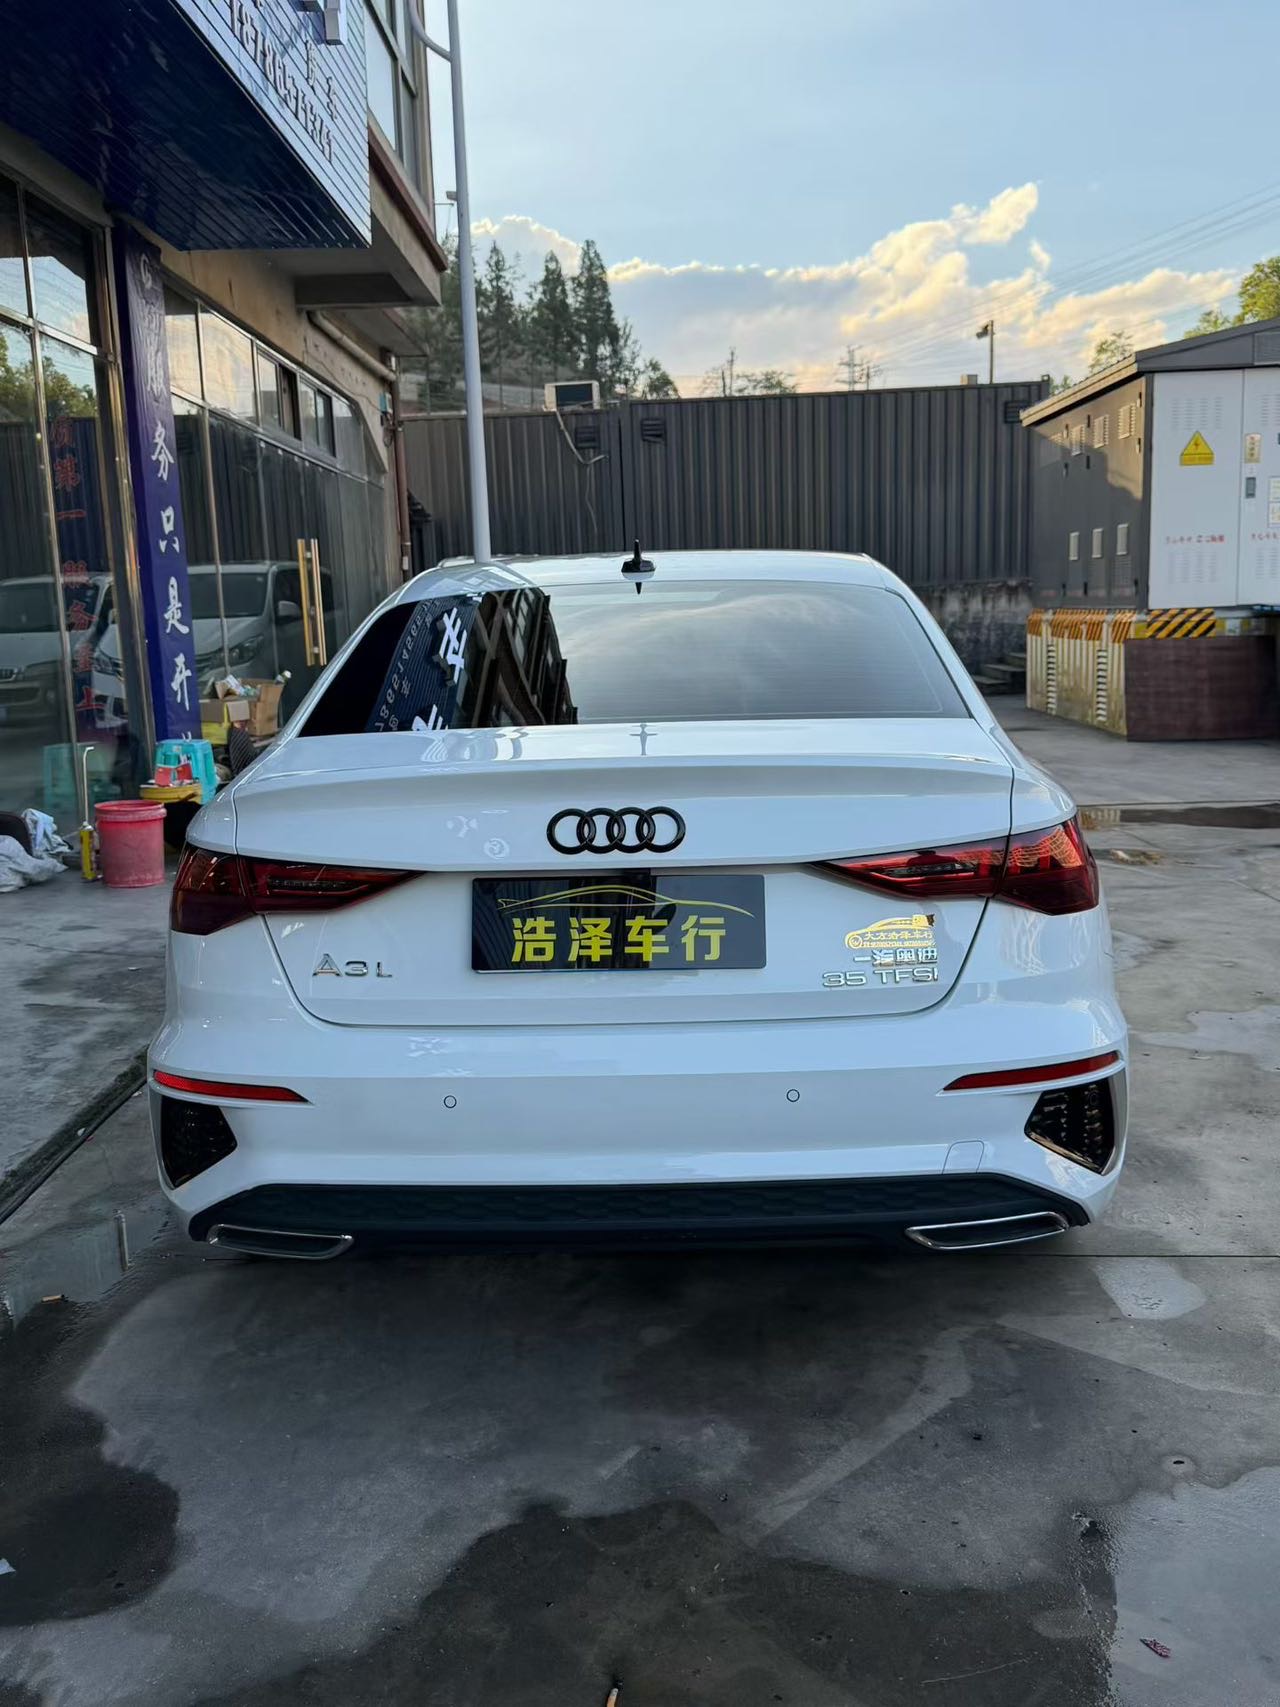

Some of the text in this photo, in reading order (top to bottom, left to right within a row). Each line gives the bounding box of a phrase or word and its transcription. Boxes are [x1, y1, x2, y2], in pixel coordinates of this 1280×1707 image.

[511, 915, 726, 962] 浩泽车行
[312, 953, 393, 978] A3L
[823, 967, 938, 987] 35 TFSI
